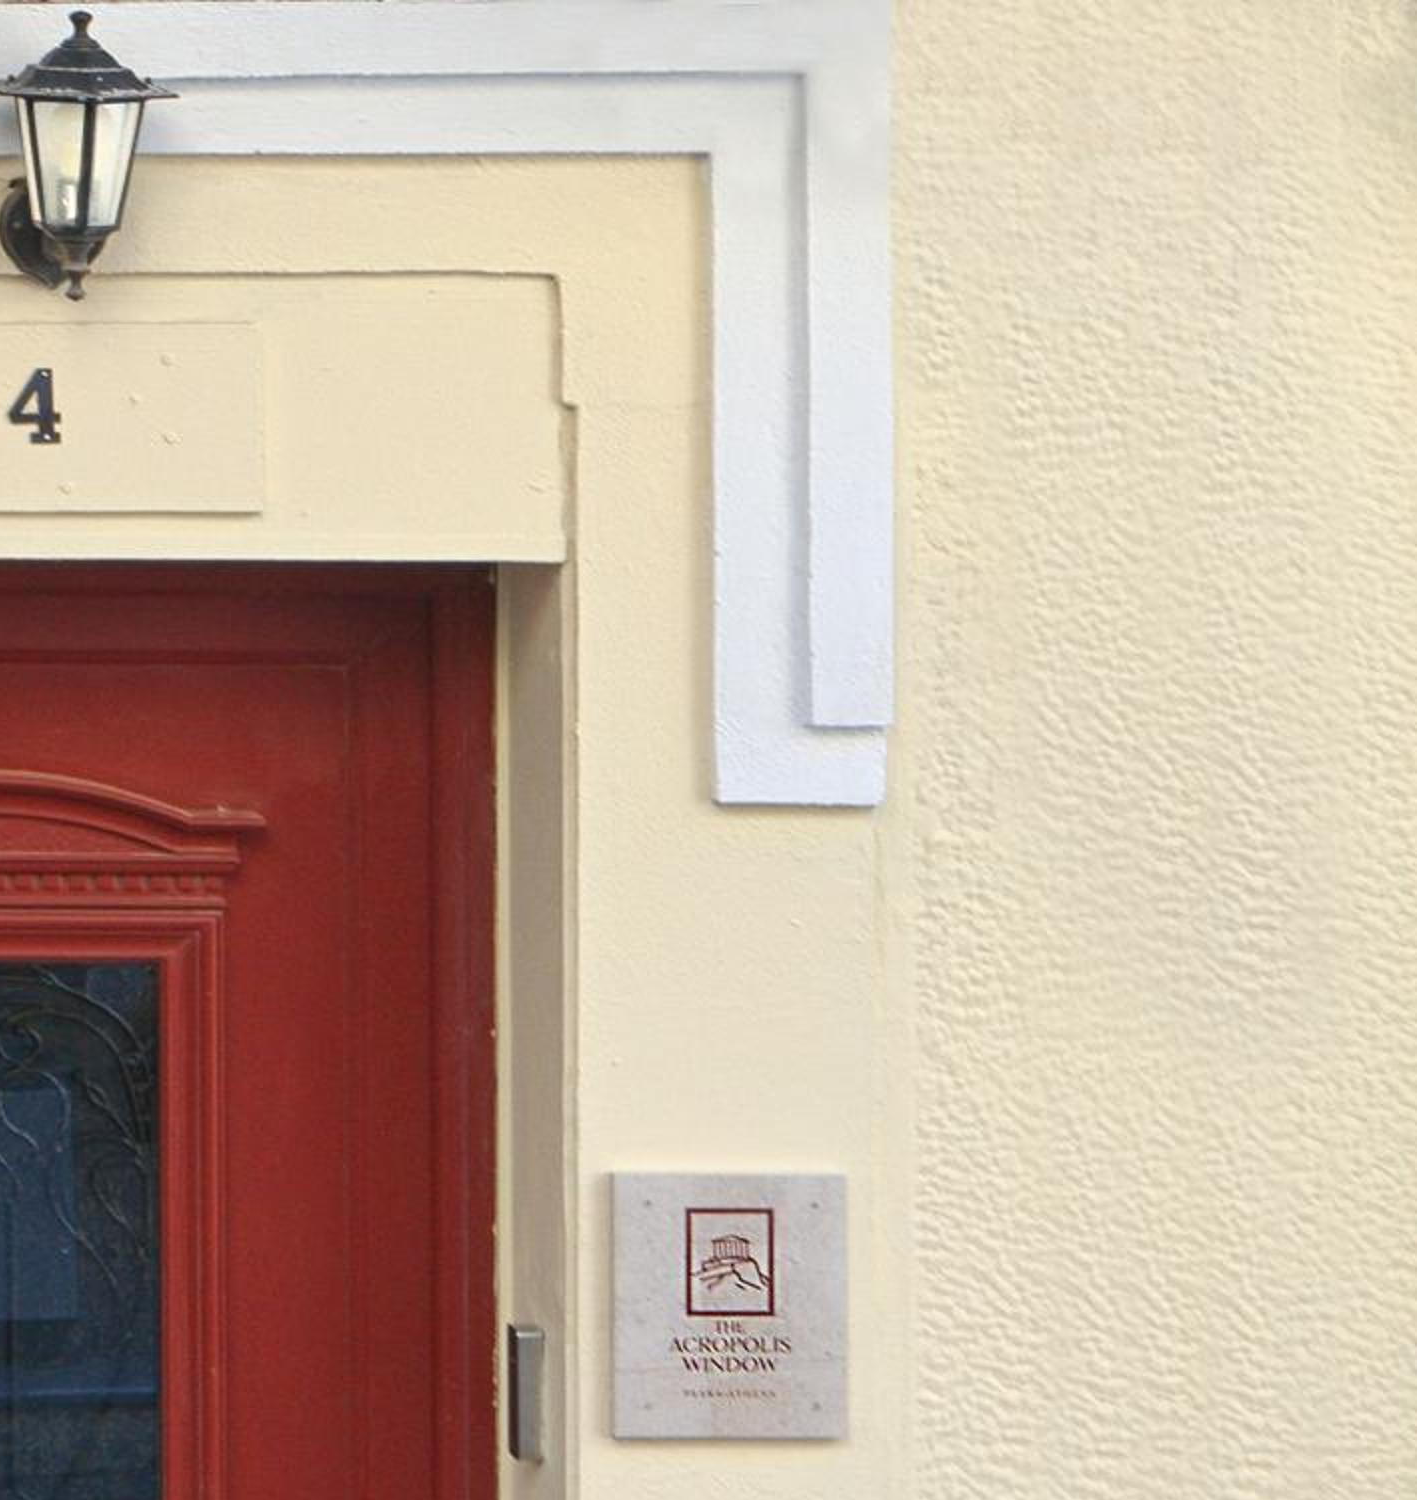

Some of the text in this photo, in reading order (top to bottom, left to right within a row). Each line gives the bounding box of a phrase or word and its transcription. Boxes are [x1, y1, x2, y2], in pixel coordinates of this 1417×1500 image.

[8, 368, 61, 444] 4
[715, 1320, 745, 1334] THE
[670, 1336, 791, 1353] ACROPOLIS
[681, 1356, 779, 1373] WINDOW
